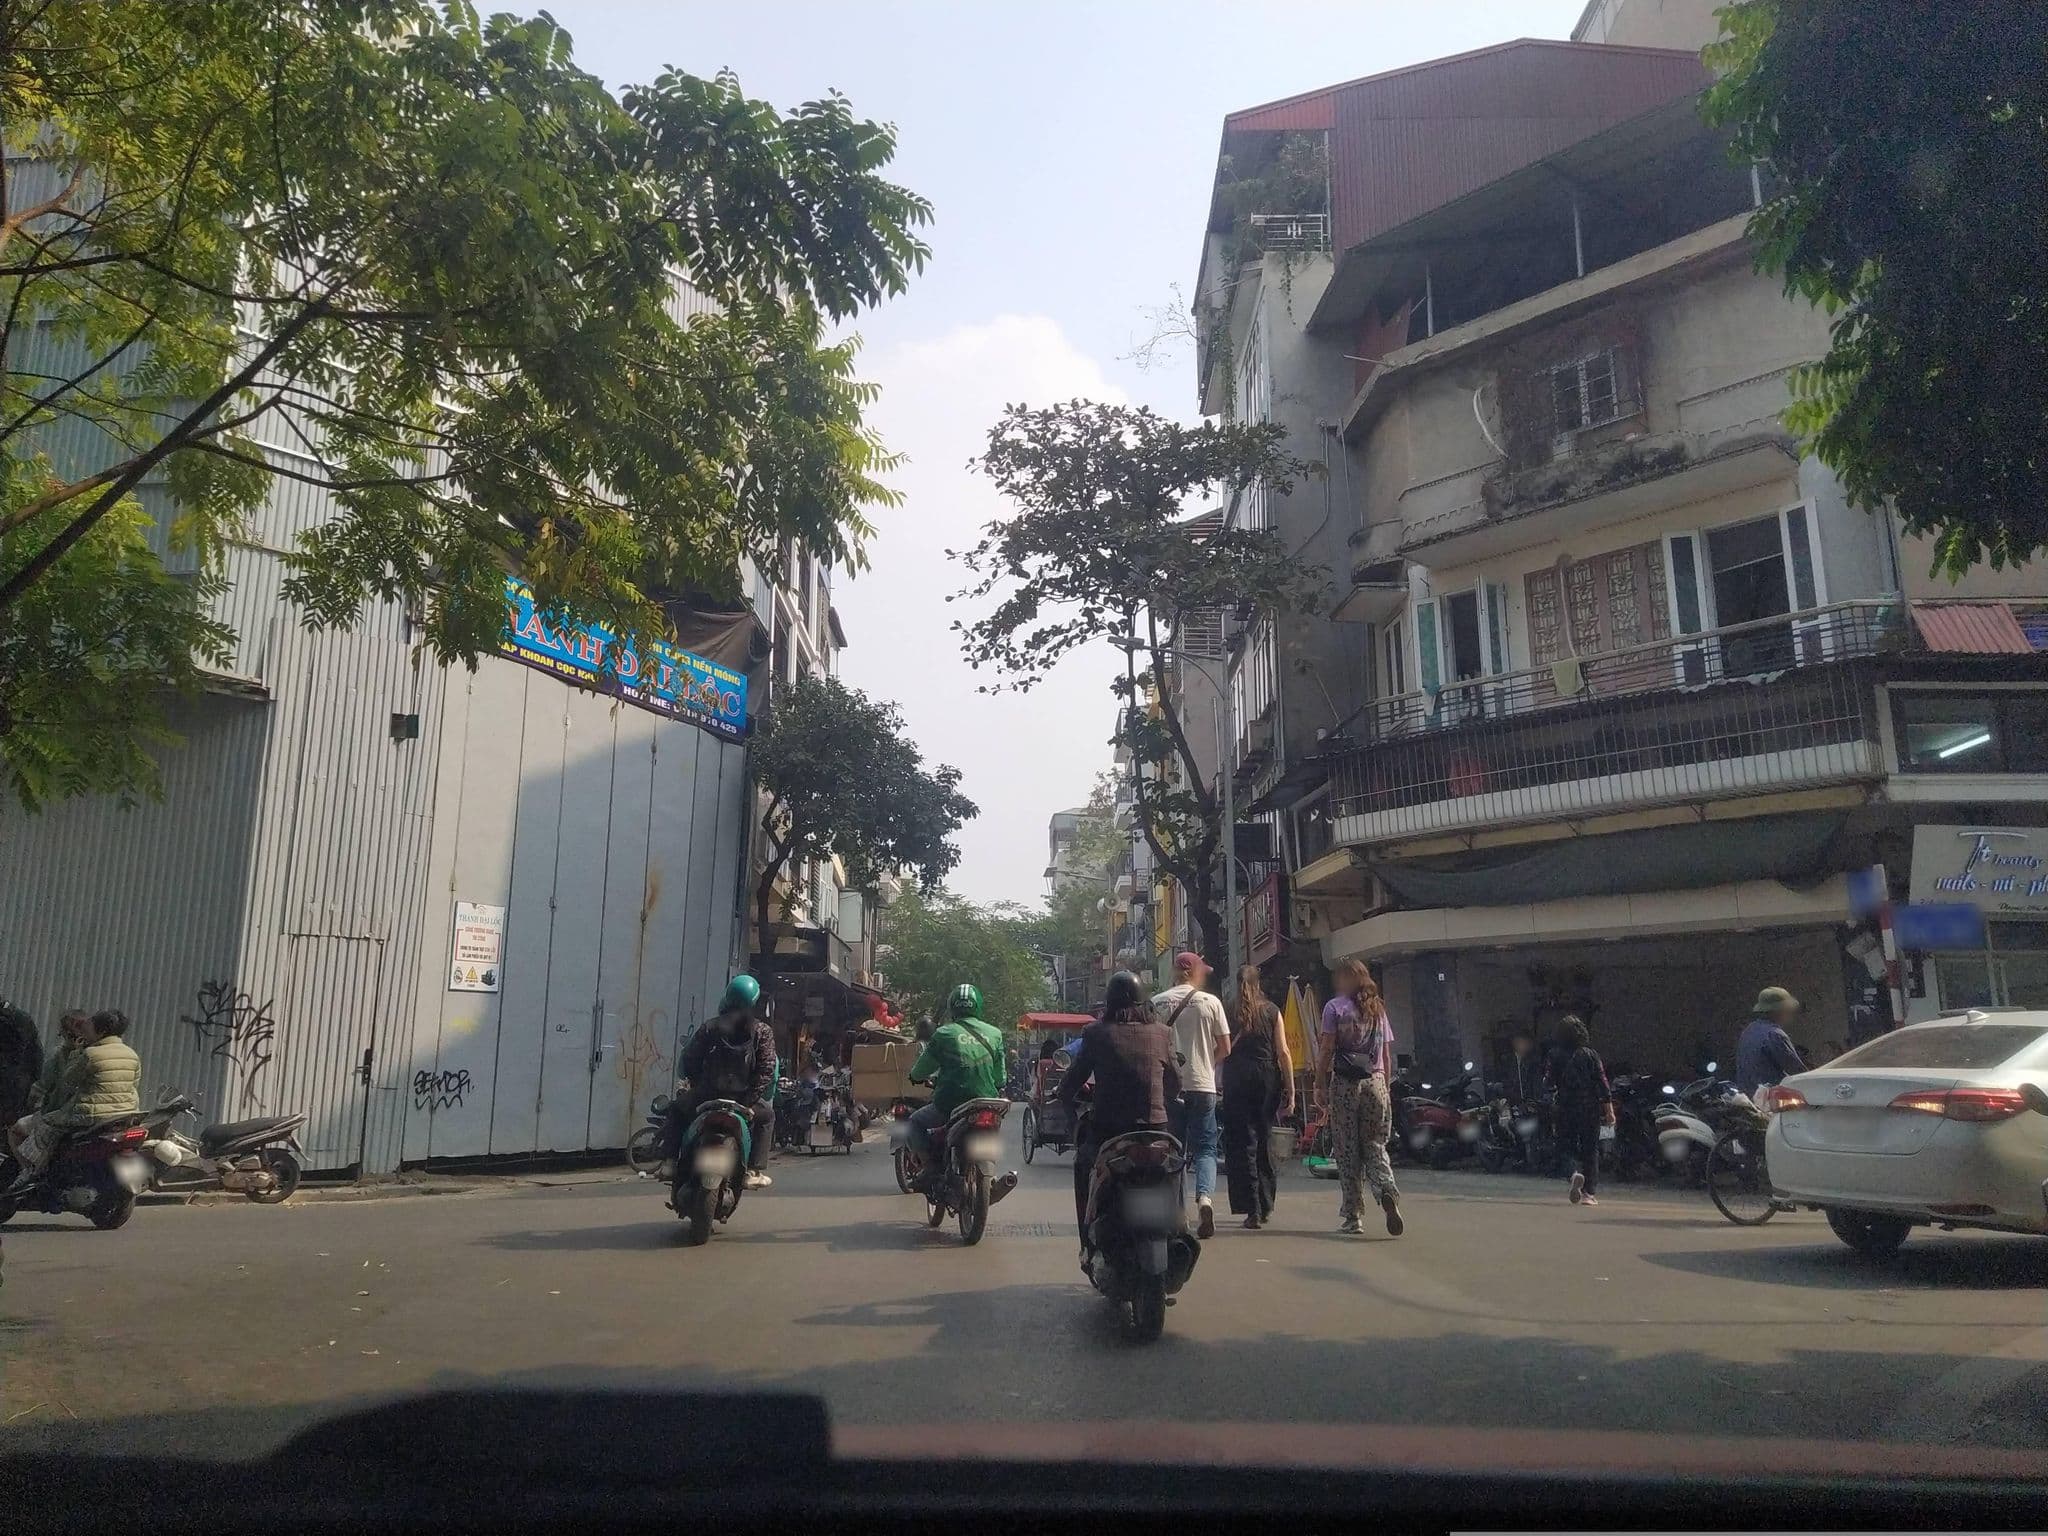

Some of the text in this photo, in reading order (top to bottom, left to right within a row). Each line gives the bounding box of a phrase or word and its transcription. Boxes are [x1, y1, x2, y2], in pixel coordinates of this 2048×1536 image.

[519, 647, 555, 668] KHOAN
[556, 661, 576, 676] CỌC
[719, 721, 737, 735] 425
